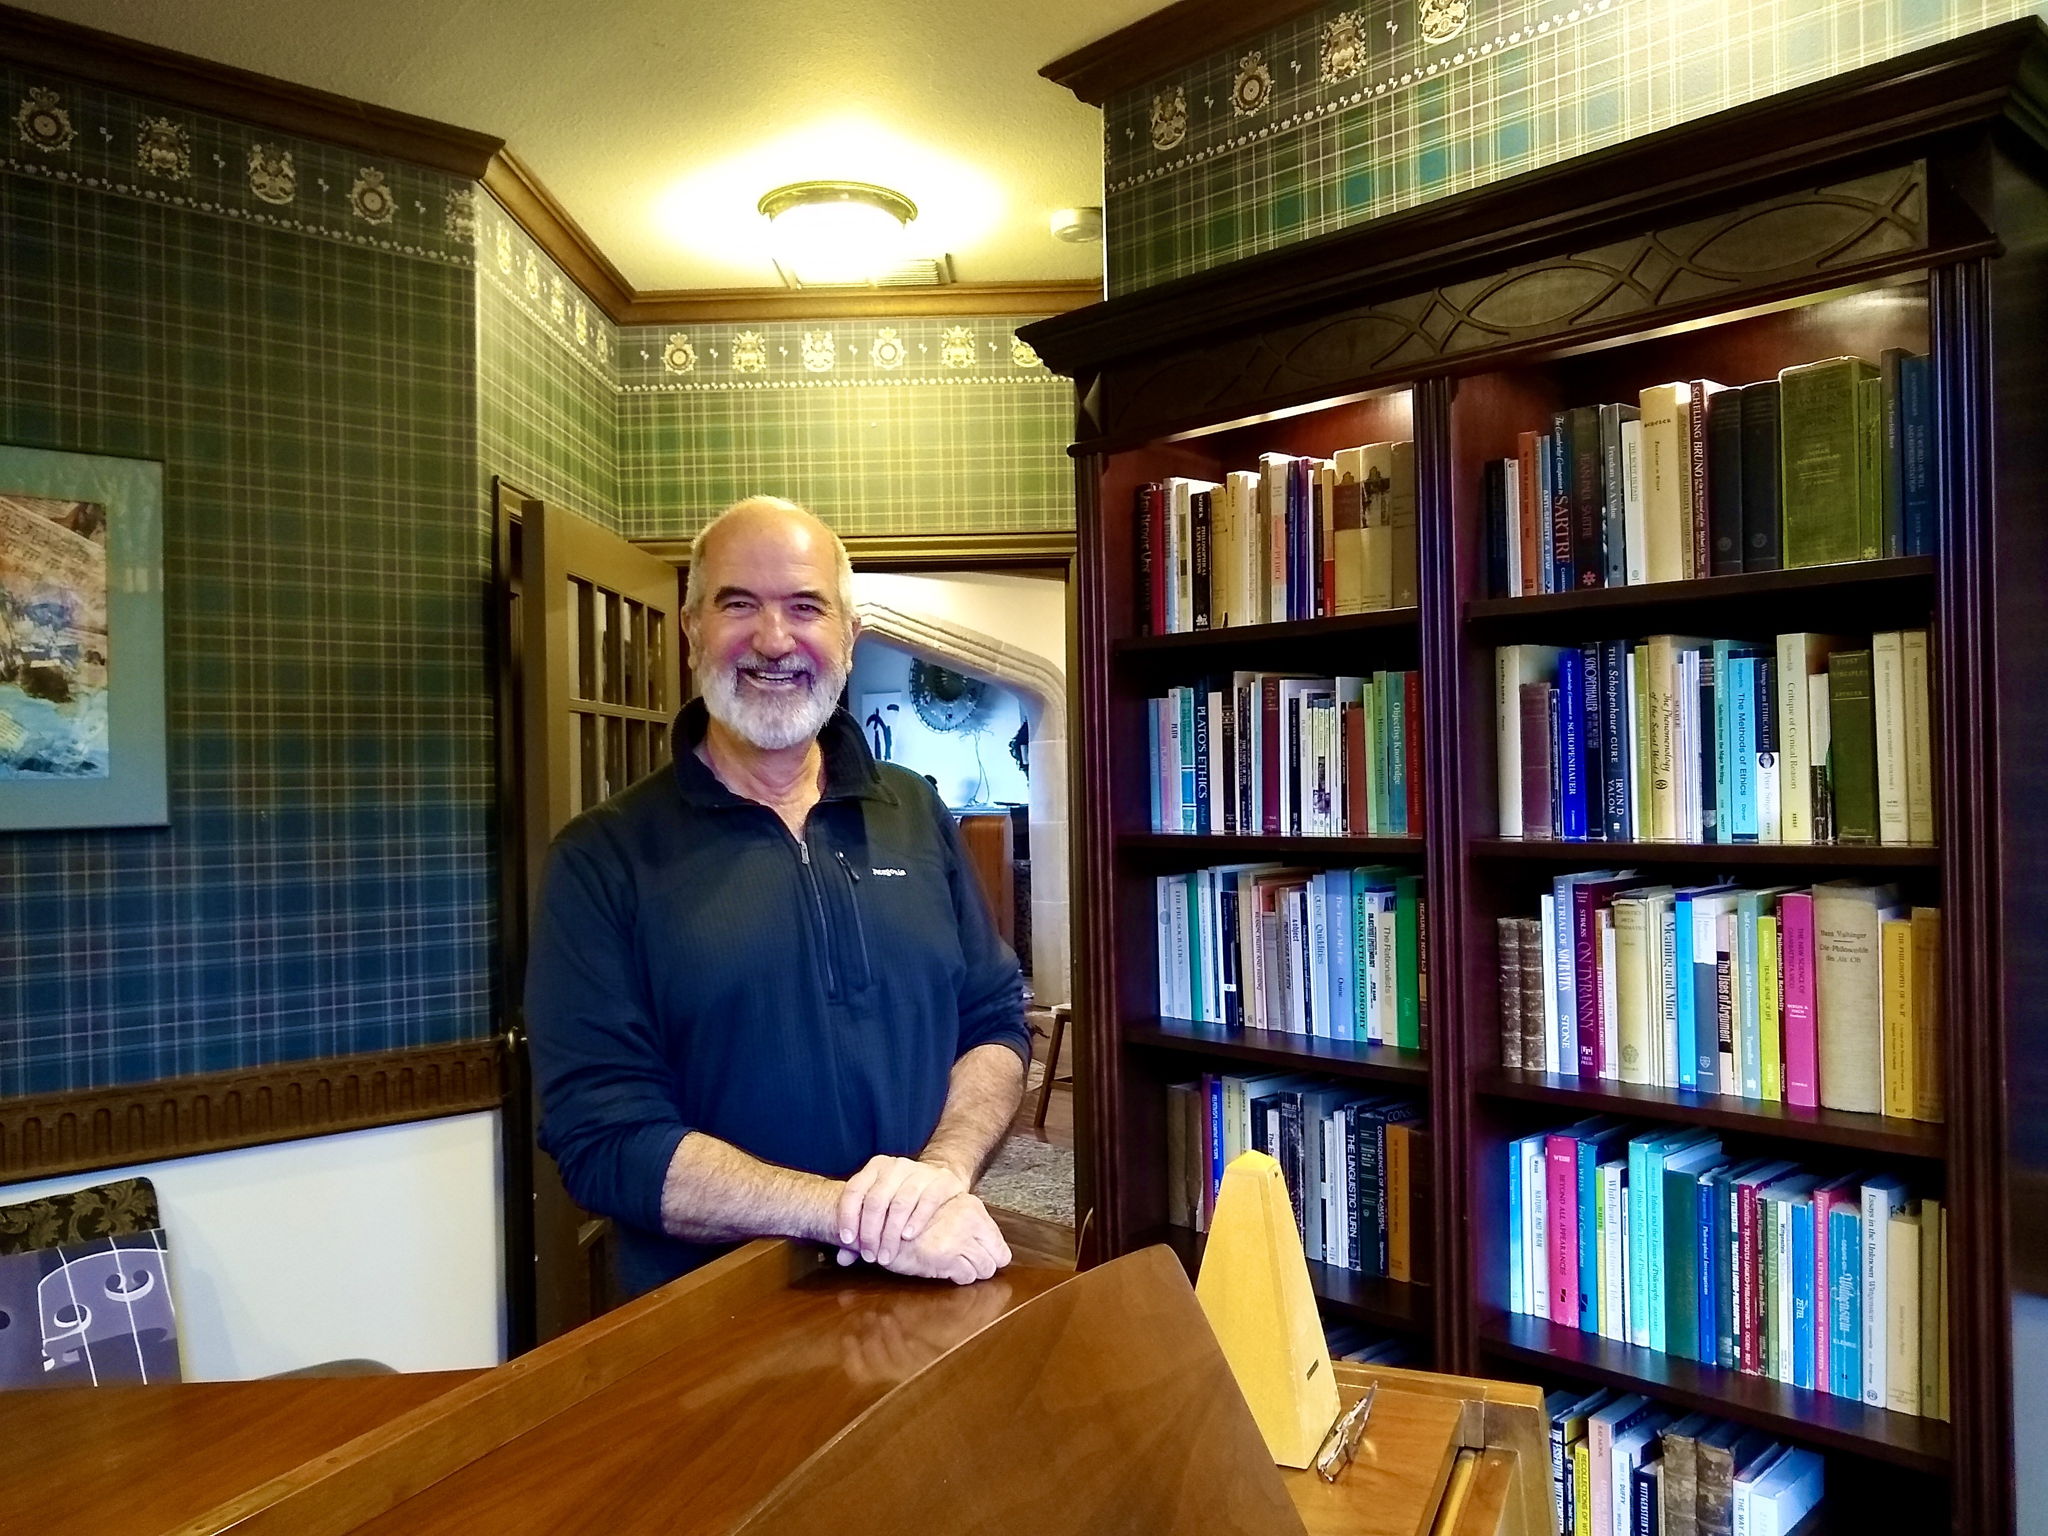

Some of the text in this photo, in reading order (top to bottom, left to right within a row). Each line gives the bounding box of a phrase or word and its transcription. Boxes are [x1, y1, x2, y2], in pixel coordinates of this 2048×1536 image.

[1555, 416, 1565, 489] The Cambridge Companion
[1692, 386, 1704, 477] SCHELLING BRUNO
[1608, 445, 1618, 519] Freedom As A Value
[1629, 456, 1637, 476] BODY
[1630, 485, 1638, 502] PAIN
[1554, 496, 1571, 564] SARTRE
[1582, 504, 1592, 538] SARTRE
[1585, 657, 1598, 712] SCHOPENHAUER
[1760, 663, 1768, 686] Writings
[1606, 647, 1619, 763] THE Schopenhauer CURE
[1639, 694, 1647, 723] Existence
[1651, 691, 1659, 701] of
[1197, 706, 1208, 799] PLATO'S ETHICS
[1377, 718, 1385, 746] History
[1392, 702, 1402, 785] Objective Knowledge
[1651, 721, 1660, 747] Social
[1661, 692, 1673, 772] The Phenomenology
[1738, 693, 1749, 796] The Methods of Ethics
[1762, 734, 1770, 750] LIFE
[1785, 682, 1799, 790] Critique of Cynical Reason
[1567, 721, 1577, 796] SCHOPENHAUER
[1640, 740, 1648, 770] Freedom
[1651, 748, 1661, 775] World
[1608, 779, 1617, 814] YALOM
[1615, 778, 1624, 818] IRVIN D.
[1336, 896, 1344, 911] The
[1336, 912, 1344, 929] Time
[1558, 905, 1567, 931] TRIAL
[1292, 923, 1300, 942] object
[1315, 923, 1325, 965] Quiddities
[1337, 929, 1345, 937] of
[1559, 931, 1567, 946] OF
[1819, 943, 1830, 951] Die
[1383, 927, 1392, 994] The Rationalists
[1558, 948, 1571, 992] SOCRATES
[1663, 921, 1676, 1021] Meaning and Mind
[1777, 932, 1785, 1012] Philosophical Relativity
[1898, 947, 1906, 989] PHILOSOPHY
[1337, 977, 1345, 998] Quine
[1358, 968, 1366, 1029] PHILOSOPHY
[1578, 942, 1593, 1032] ON TYRANNY
[1718, 960, 1731, 1043] The Uses of Argument
[1745, 975, 1753, 1027] Self-Determination
[1765, 1001, 1772, 1011] OF
[1899, 990, 1906, 999] OF
[1561, 1014, 1570, 1049] STONE
[1578, 1146, 1586, 1166] PAUL
[1347, 1134, 1358, 1238] THE LINGUISTIC TURN
[1378, 1177, 1385, 1187] OF
[1559, 1174, 1567, 1204] BEYOND
[1608, 1179, 1617, 1224] Whitehead
[1535, 1217, 1543, 1230] AND
[1536, 1232, 1544, 1248] MAN
[1579, 1205, 1588, 1268] First Considerations
[1768, 1203, 1778, 1284] WITTGENSTEIN
[1818, 1223, 1824, 1232] TO
[1559, 1222, 1568, 1276] APPEARANCES
[1867, 1194, 1877, 1323] Essays in the Unknown Wittgenstein
[1743, 1261, 1751, 1329] LOGICO-PHILOSOPHICUS
[1796, 1297, 1804, 1319] ZETTEL
[1832, 1273, 1854, 1332] Wittgenstein
[1552, 1429, 1564, 1480] THE ESSENTIAL
[1580, 1453, 1589, 1521] RECOLLECTIONS OF
[1640, 1481, 1649, 1534] WITTGENSTEIN'S
[1737, 1498, 1745, 1512] THE
